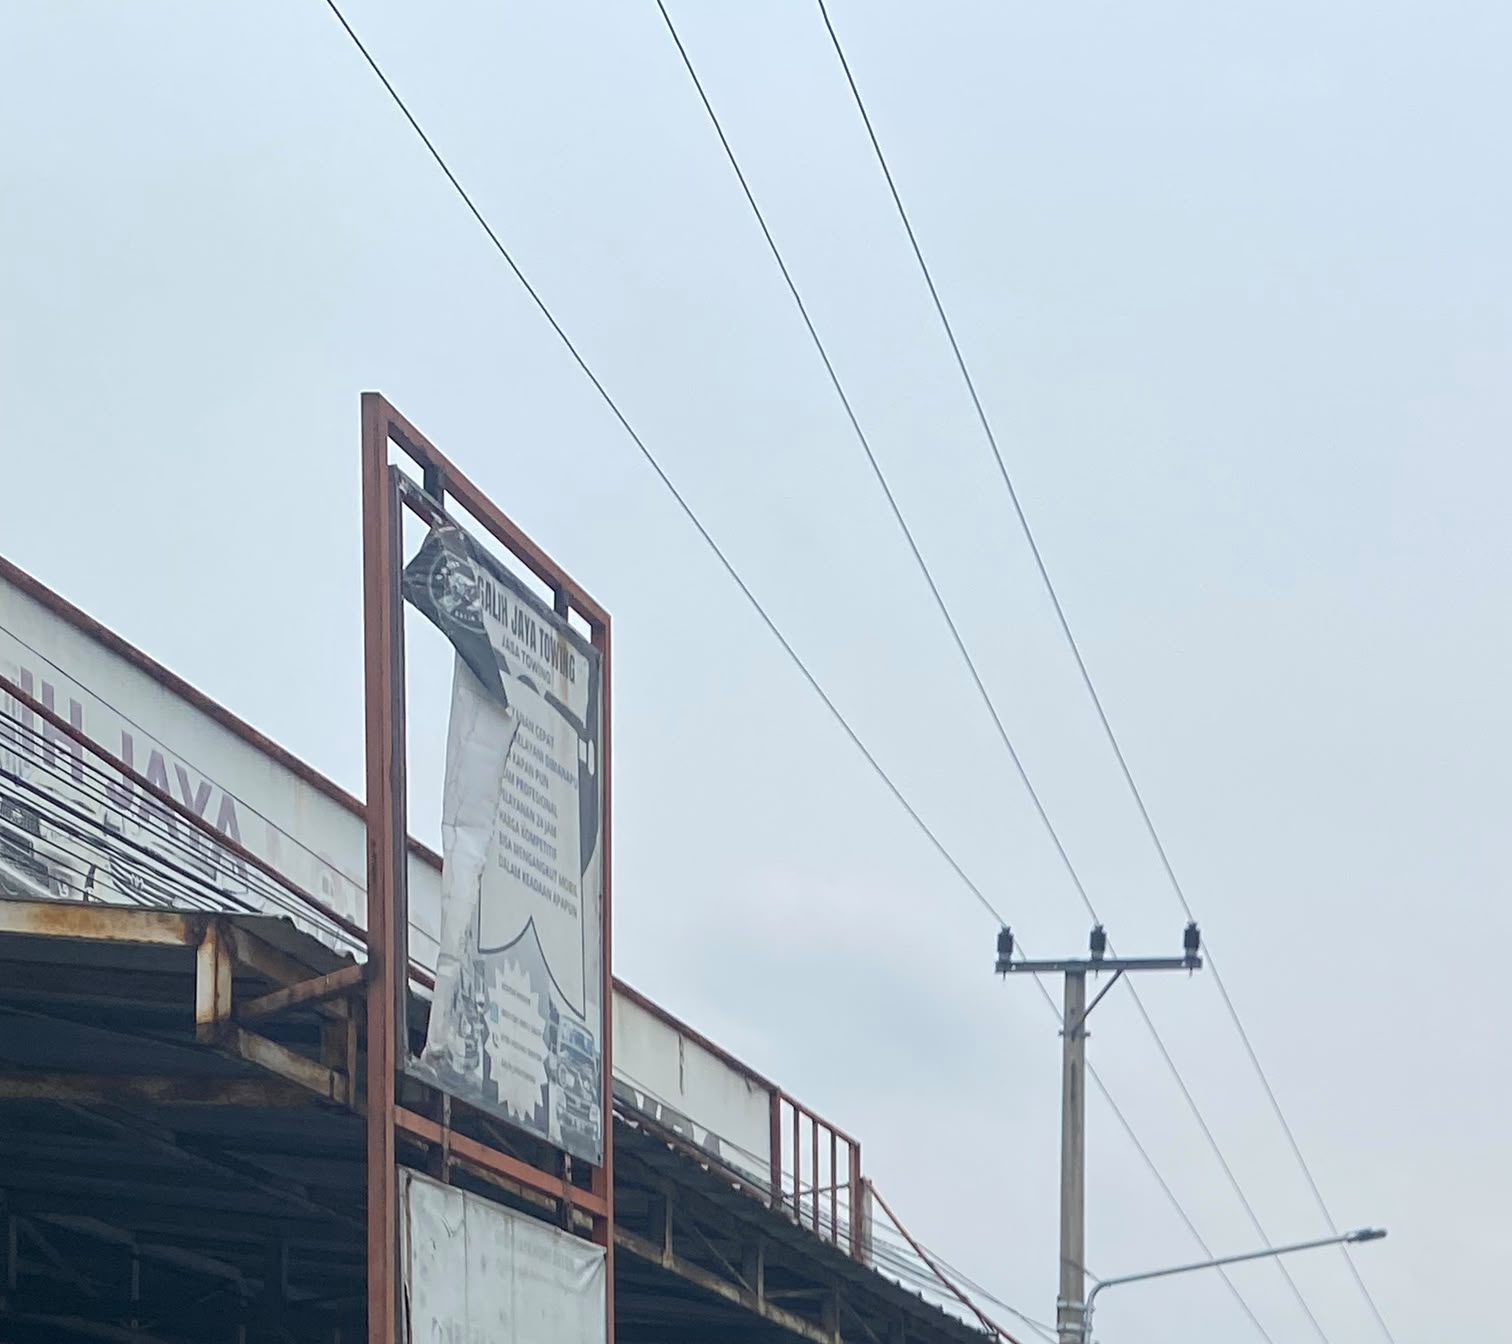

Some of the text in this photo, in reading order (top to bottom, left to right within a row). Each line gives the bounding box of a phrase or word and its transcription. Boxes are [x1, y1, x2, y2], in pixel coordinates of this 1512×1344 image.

[511, 604, 538, 650] JAYA
[540, 627, 576, 684] TOWING
[105, 728, 250, 883] JAYA
